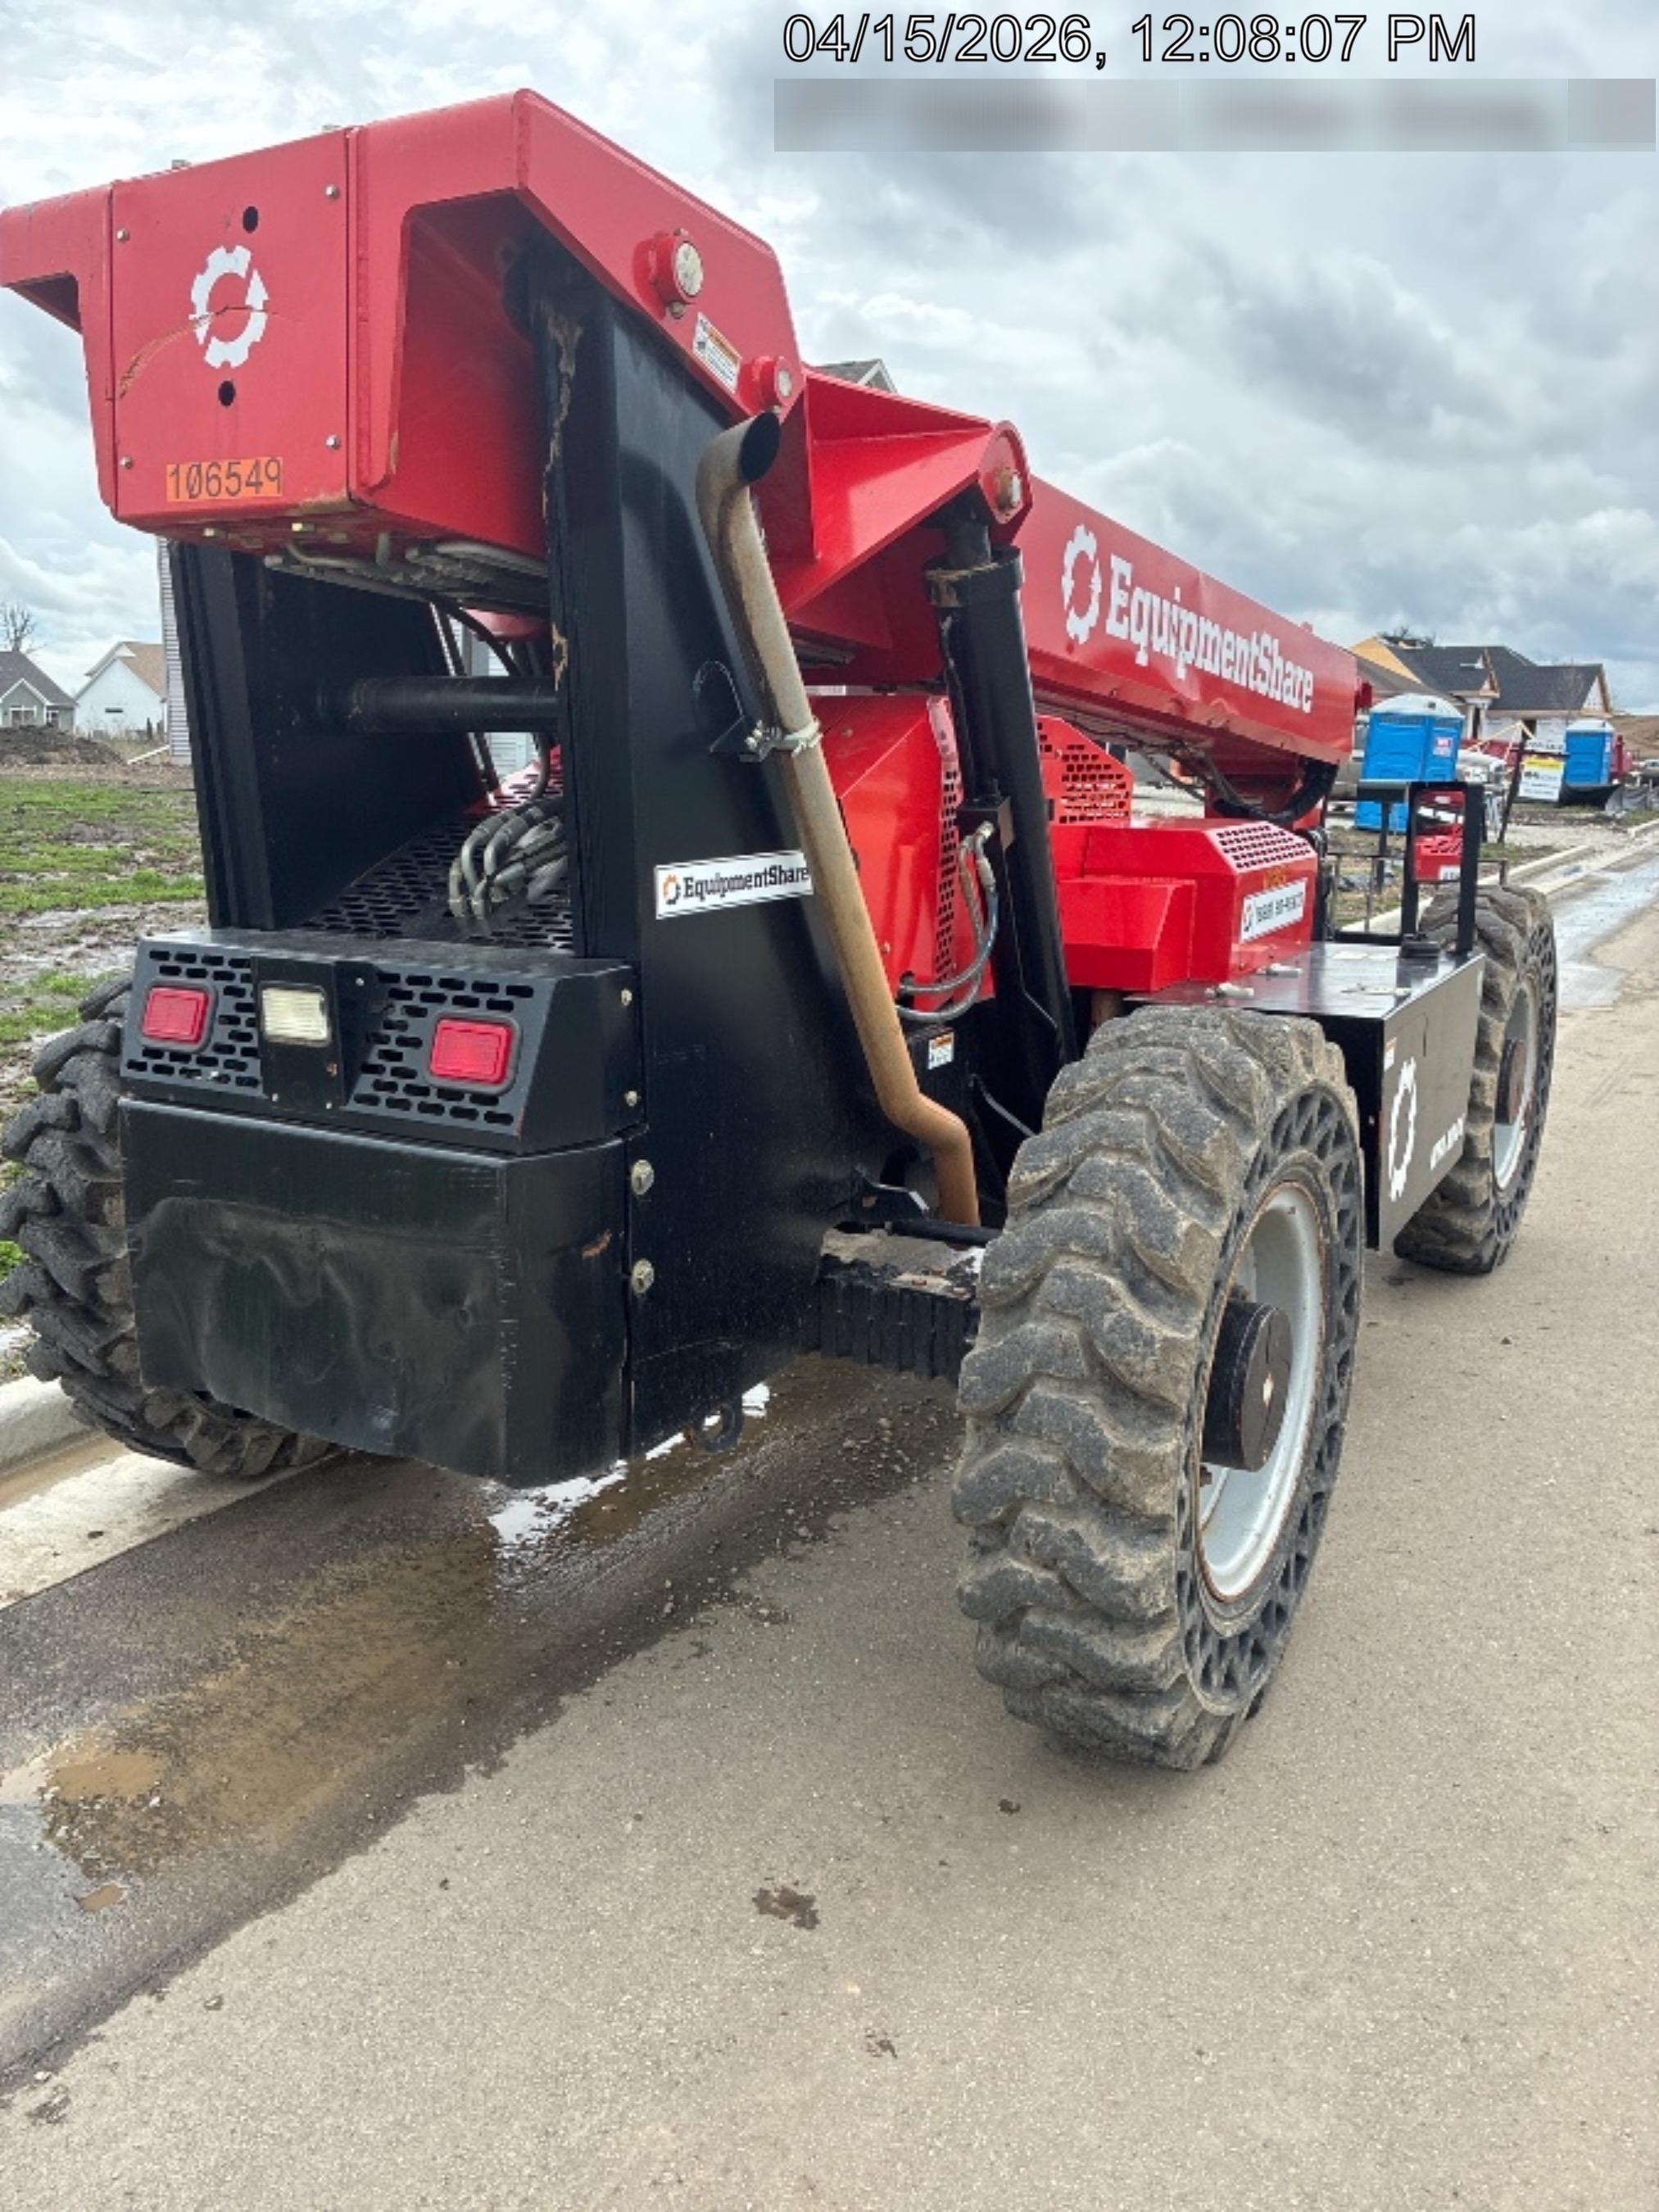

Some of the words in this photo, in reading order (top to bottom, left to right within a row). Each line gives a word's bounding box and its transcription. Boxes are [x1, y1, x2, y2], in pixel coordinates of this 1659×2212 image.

[170, 458, 281, 499] 106549
[1106, 555, 1313, 713] EquipmentShare
[682, 864, 810, 900] EquipmentShare
